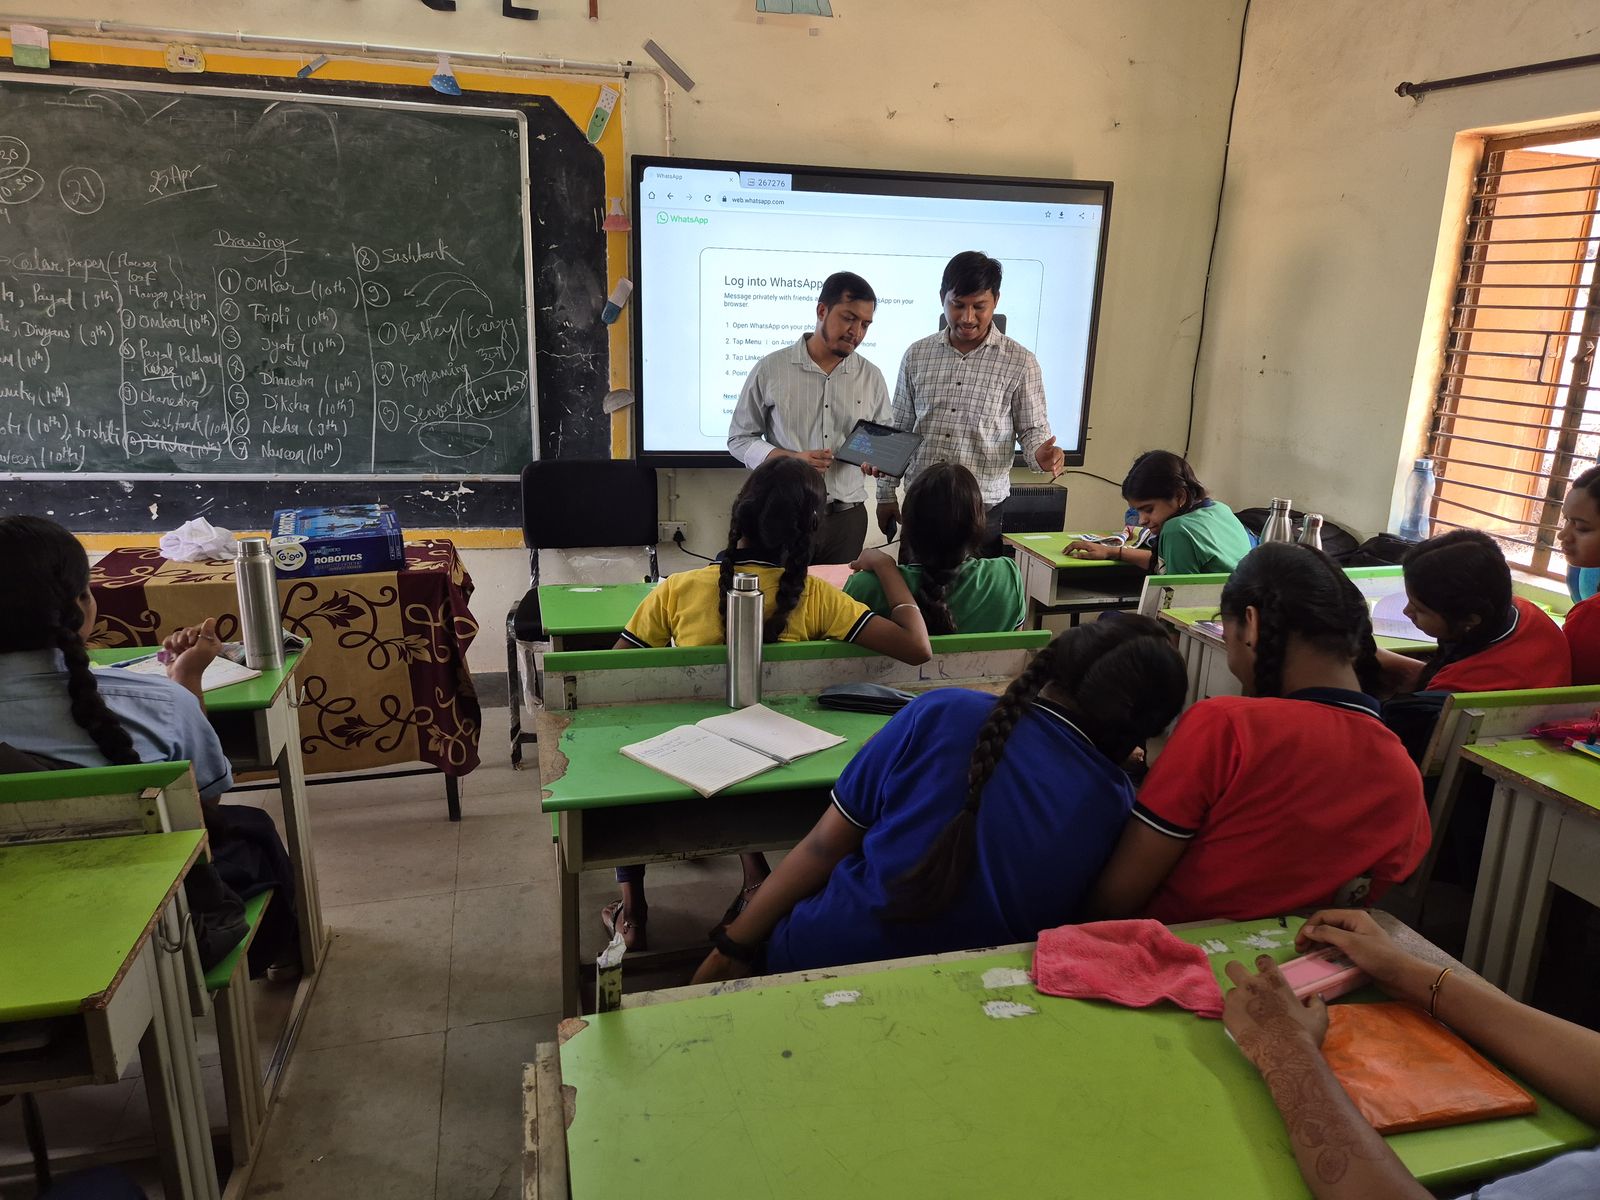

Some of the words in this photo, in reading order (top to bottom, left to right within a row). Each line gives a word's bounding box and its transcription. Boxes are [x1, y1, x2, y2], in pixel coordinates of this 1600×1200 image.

[656, 173, 683, 181] WhatsApp
[757, 178, 786, 188] 267276
[66, 175, 96, 206] 21
[731, 197, 785, 206] web.whatsapp.com
[669, 214, 709, 225] WhatsApp
[212, 229, 287, 278] Drawing
[724, 275, 744, 288] Log
[747, 276, 767, 287] into
[770, 277, 823, 290] WhatsApp
[724, 292, 752, 302] Message
[752, 293, 778, 302] privately
[792, 294, 813, 302] friends
[732, 322, 749, 330] Open
[750, 322, 780, 331] WhatsApp
[732, 338, 744, 346] Tap
[745, 338, 762, 346] Menu
[278, 551, 301, 562] Gigo
[313, 553, 363, 565] ROBOTICS
